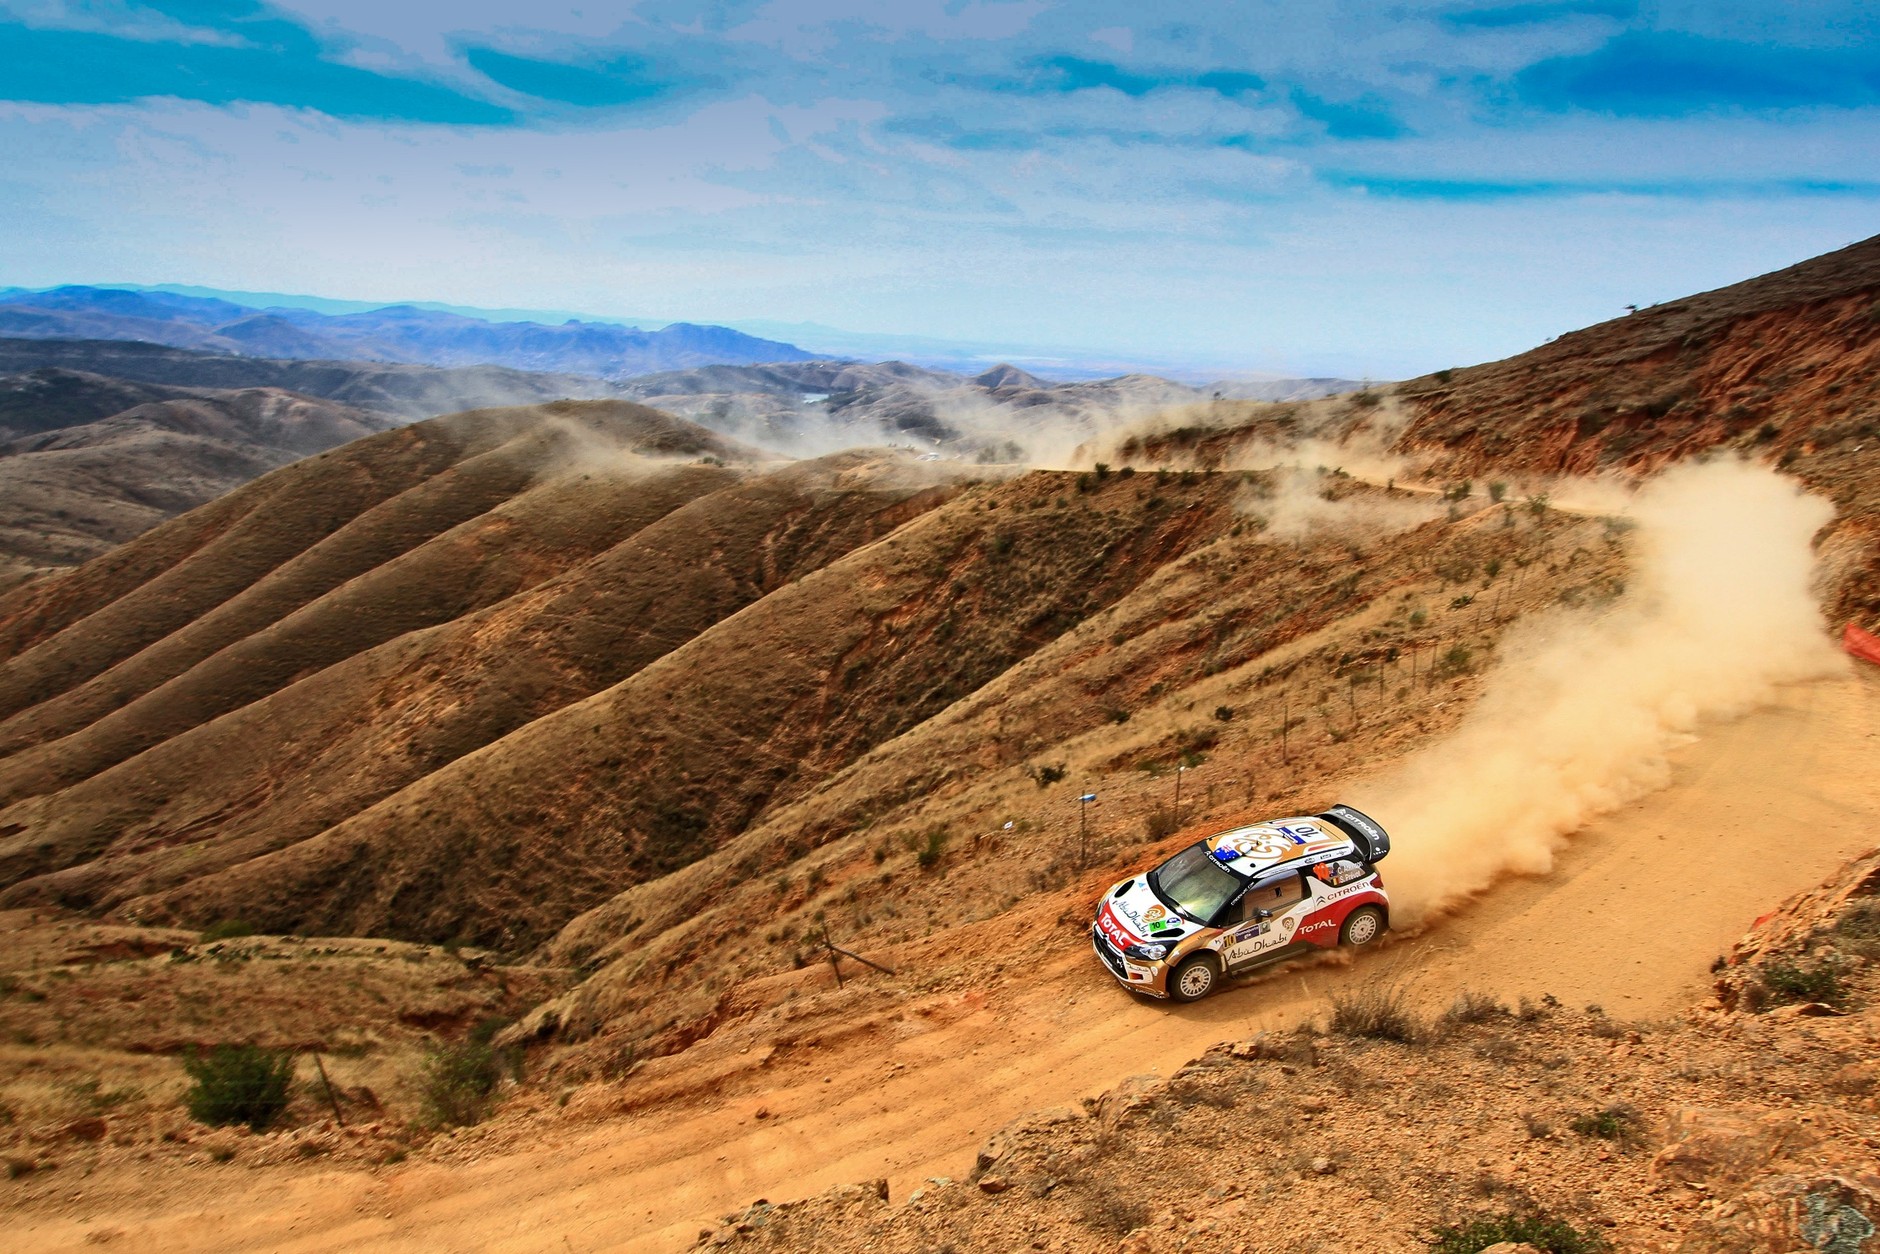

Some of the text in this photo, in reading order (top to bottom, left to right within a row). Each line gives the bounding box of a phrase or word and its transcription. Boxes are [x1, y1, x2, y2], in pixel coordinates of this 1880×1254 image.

[1295, 827, 1319, 838] 10
[1313, 862, 1330, 881] 10
[1100, 912, 1128, 946] TOTAL
[1129, 910, 1149, 935] Dhabi
[1151, 921, 1161, 929] 10
[1299, 919, 1337, 935] TOTAL
[1223, 932, 1236, 948] 10
[1227, 932, 1288, 962] Abu Dhabi
